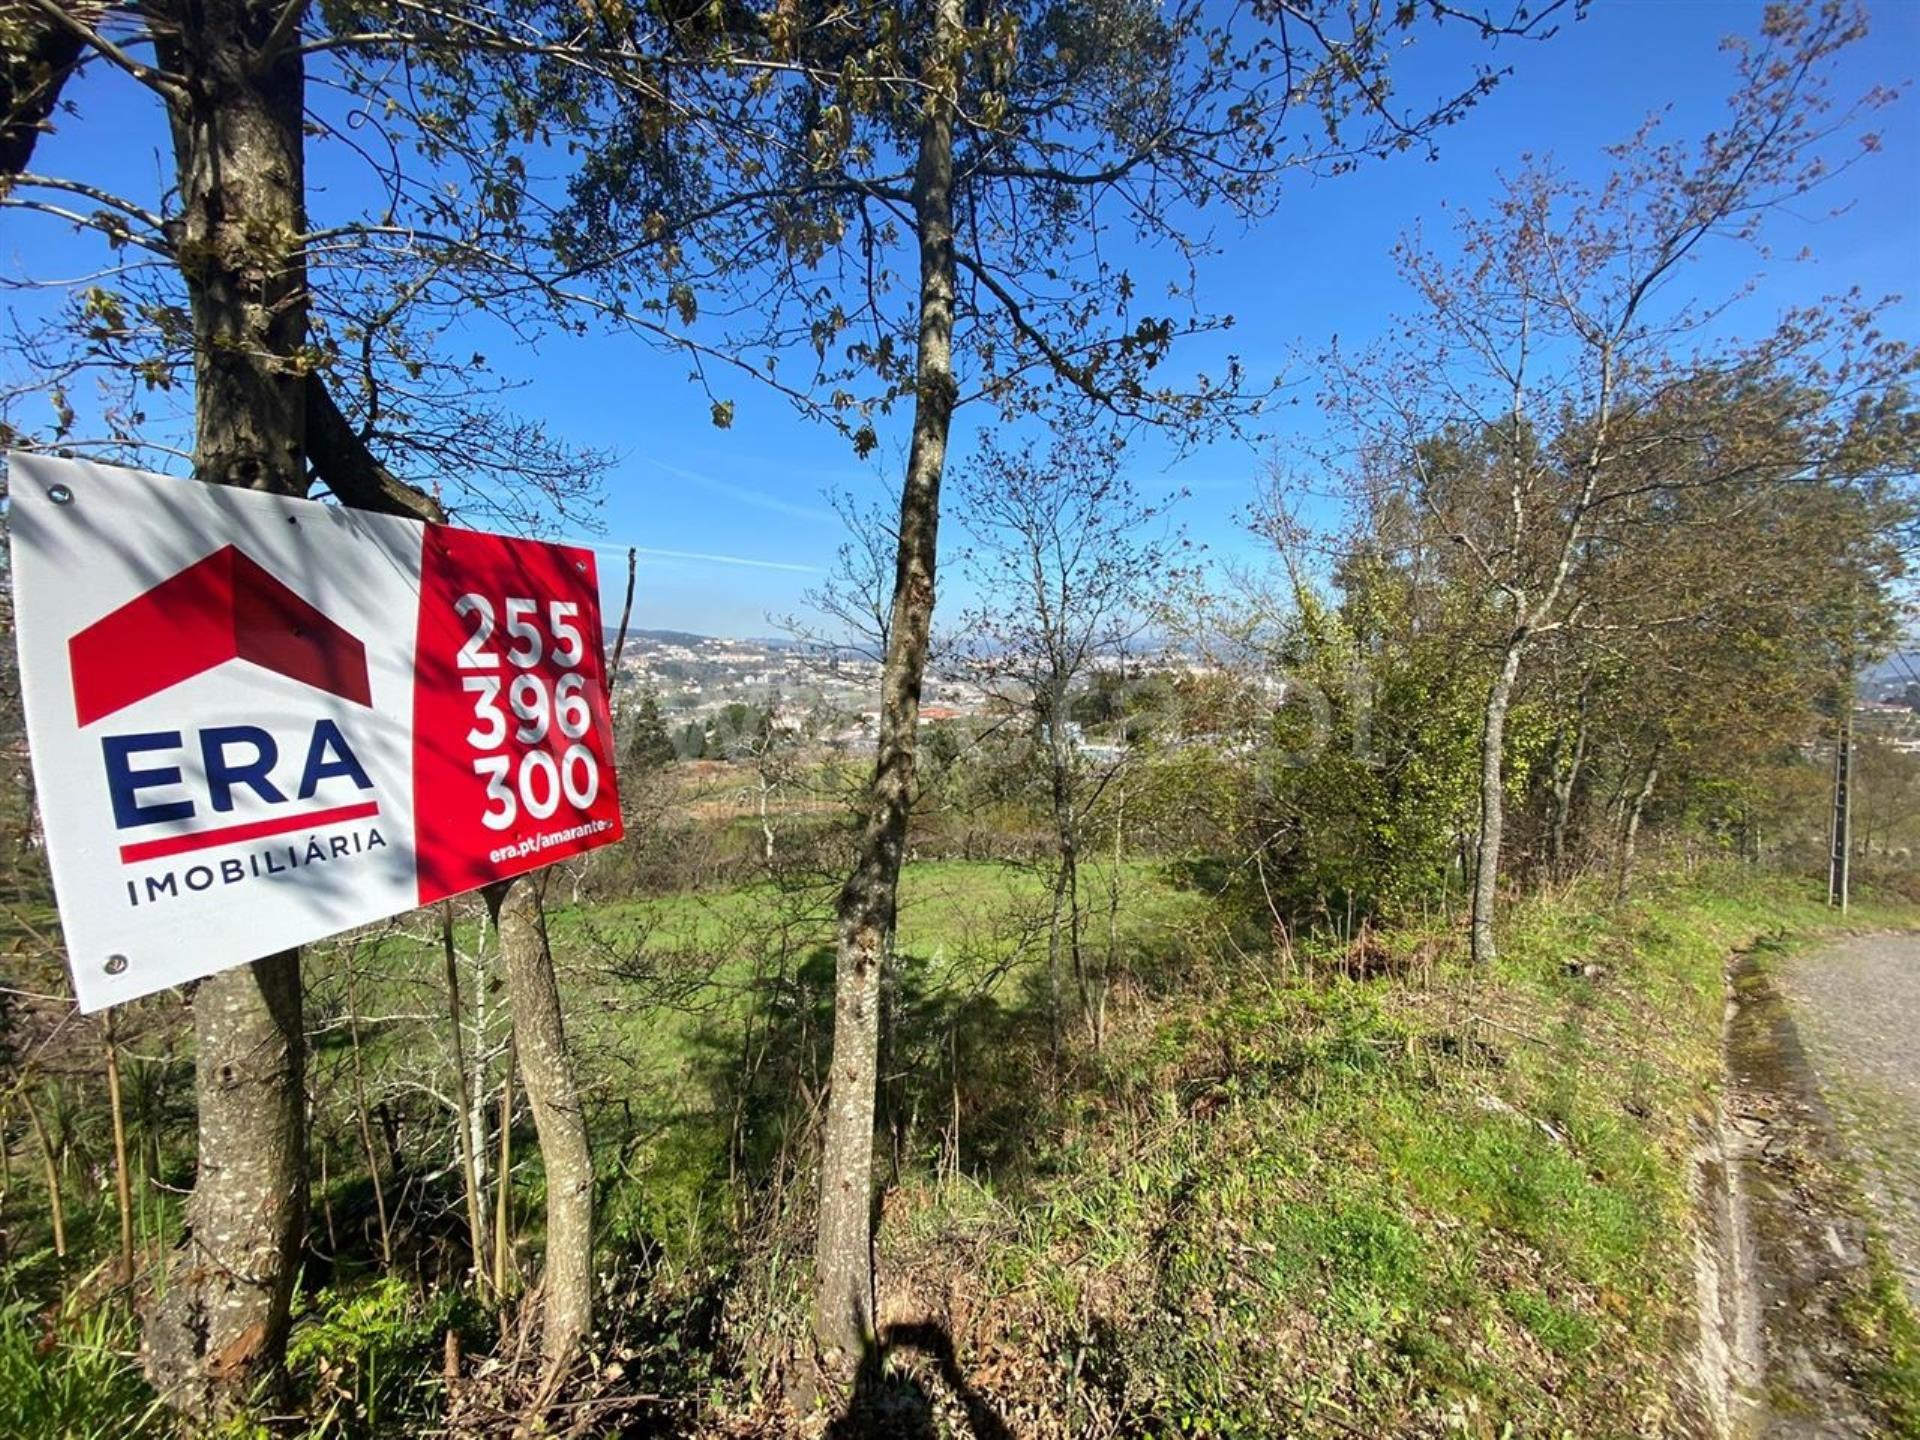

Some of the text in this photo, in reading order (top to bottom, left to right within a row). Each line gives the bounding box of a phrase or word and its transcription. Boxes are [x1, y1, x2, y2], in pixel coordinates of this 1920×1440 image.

[453, 592, 584, 669] 255
[462, 673, 591, 750] 396
[100, 717, 374, 830] ERA
[474, 744, 598, 831] 300
[127, 826, 387, 906] IMOBILIÁRIA
[489, 819, 607, 864] era.pt/amarante
